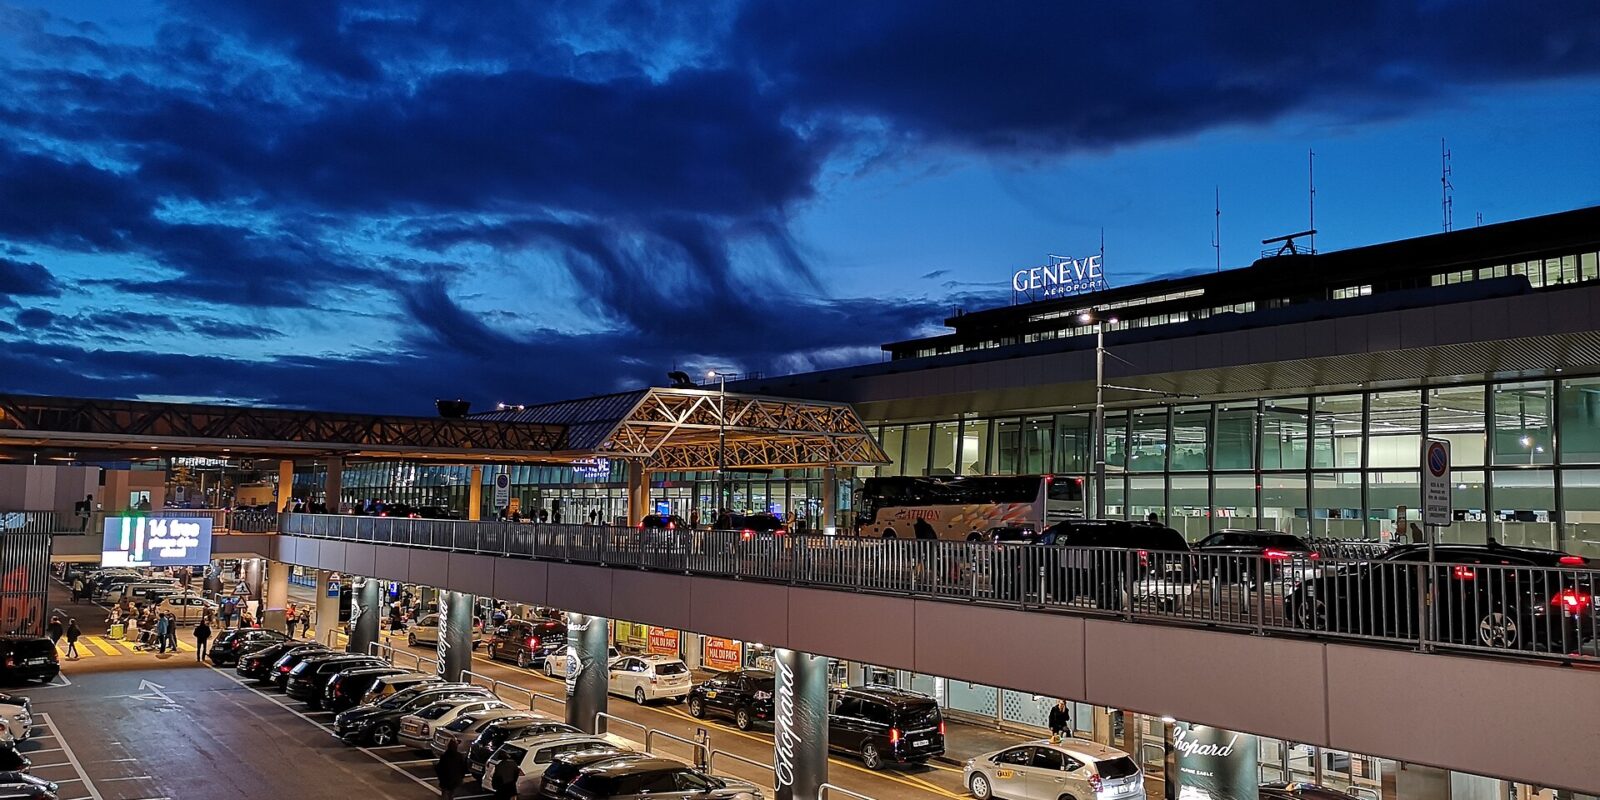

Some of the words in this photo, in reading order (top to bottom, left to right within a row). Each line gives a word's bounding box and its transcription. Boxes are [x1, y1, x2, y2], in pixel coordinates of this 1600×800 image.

[651, 636, 660, 646] MAL
[660, 638, 666, 647] DU
[666, 639, 676, 648] PAYS
[709, 648, 718, 659] MAL
[718, 649, 725, 660] DU
[725, 650, 737, 661] PAYS
[774, 648, 802, 792] Chopard
[1173, 726, 1239, 758] Chopard
